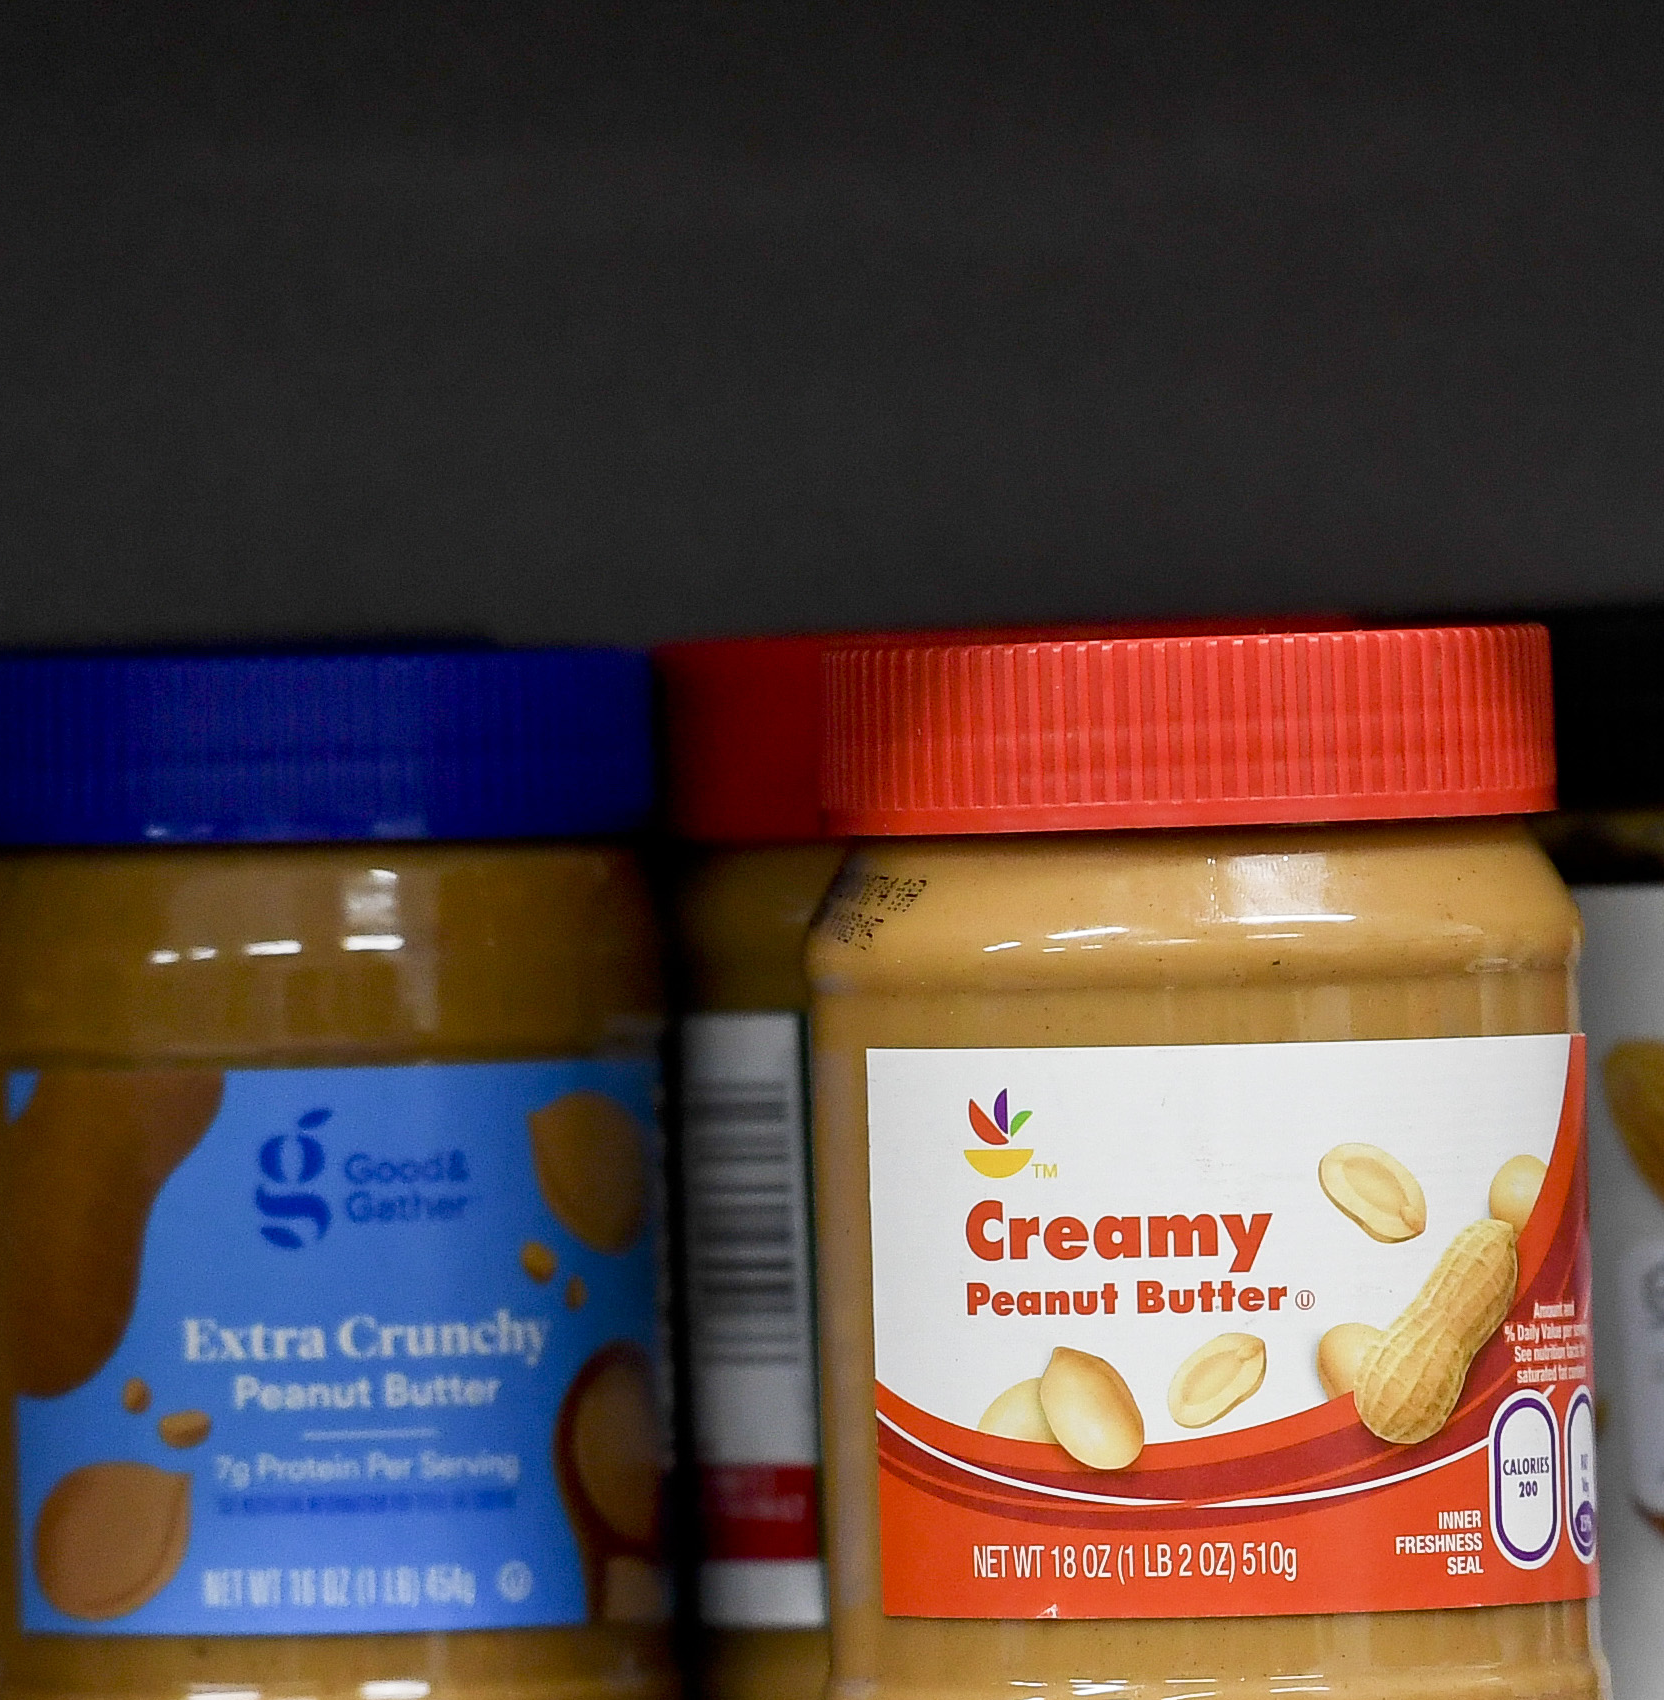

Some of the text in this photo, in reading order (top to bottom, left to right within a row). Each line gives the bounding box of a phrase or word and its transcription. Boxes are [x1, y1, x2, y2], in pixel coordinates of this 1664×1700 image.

[1033, 1164, 1058, 1178] TM
[965, 1199, 1274, 1273] Creamy
[966, 1280, 1288, 1316] Peanut Butter
[183, 1309, 549, 1367] Extra Crunchy
[1515, 1345, 1532, 1363] See
[233, 1373, 501, 1412] Peanut Butter
[1502, 1457, 1550, 1476] CALORIES
[1519, 1480, 1538, 1497] 200
[1438, 1510, 1482, 1529] INNER
[1395, 1533, 1483, 1554] FRESHNESS
[972, 1541, 1298, 1585] NET WT 18 OZ (1 LB 2 OZ) 510g
[1447, 1556, 1484, 1575] SEAL
